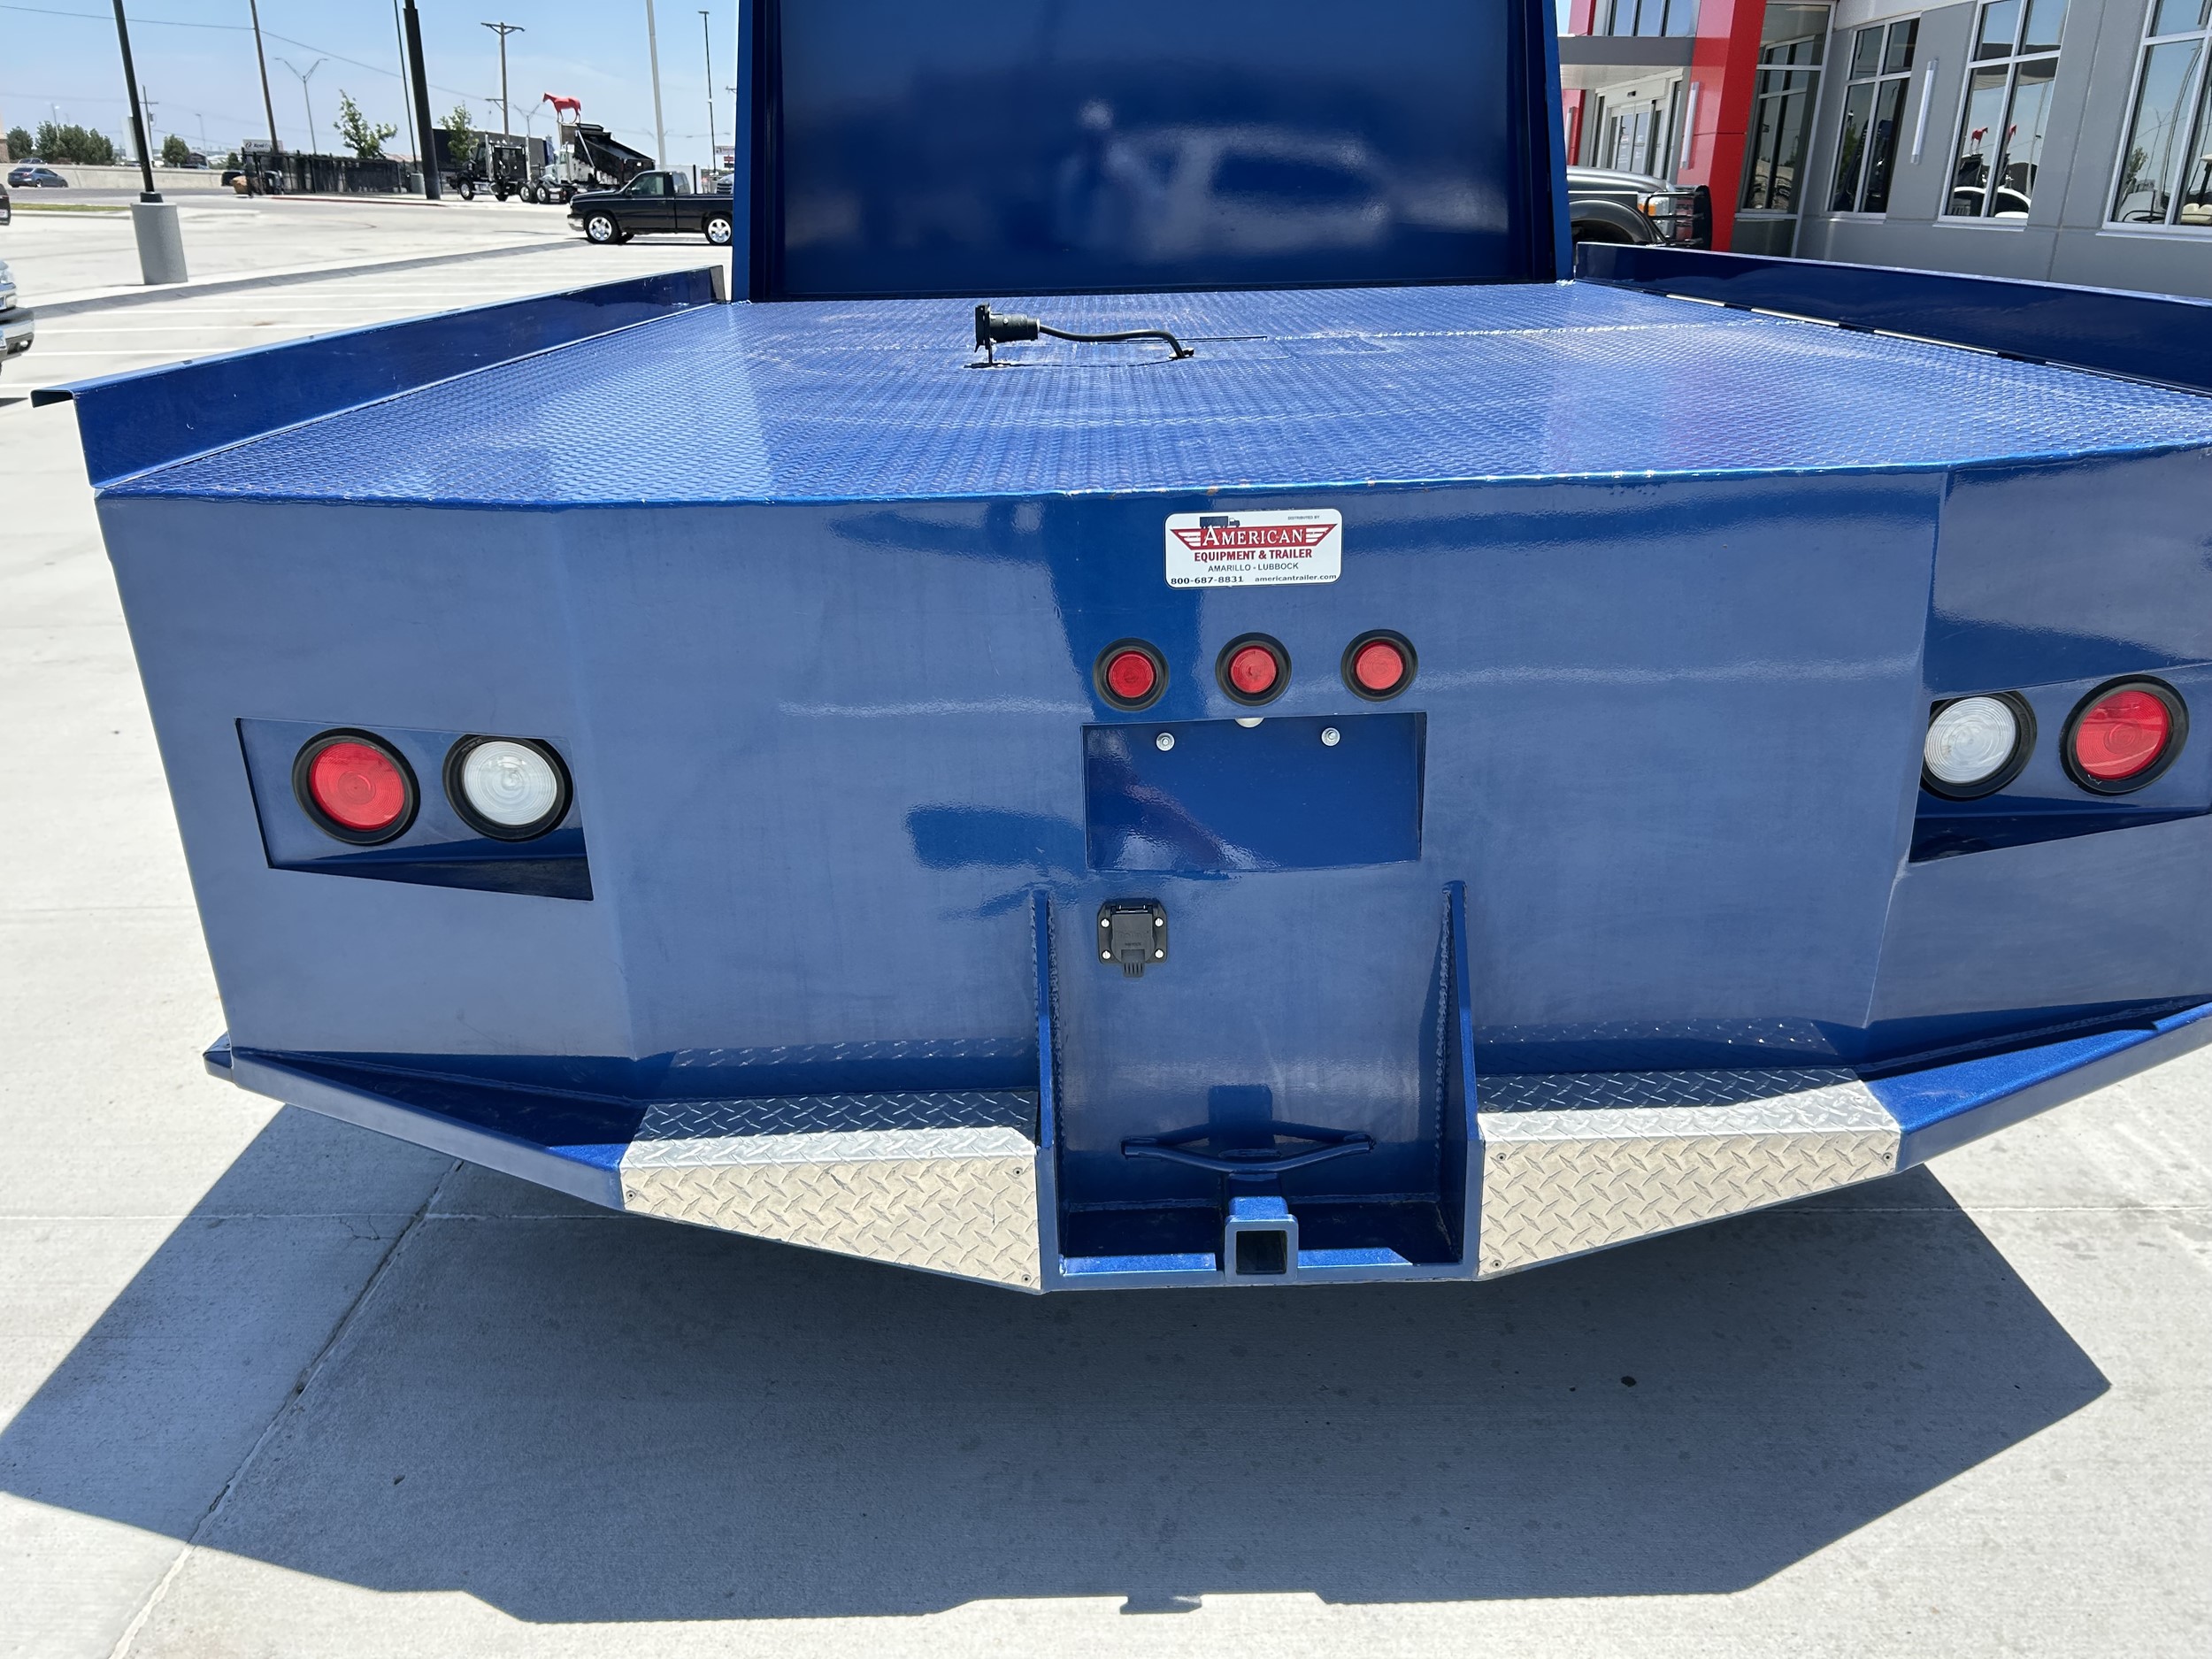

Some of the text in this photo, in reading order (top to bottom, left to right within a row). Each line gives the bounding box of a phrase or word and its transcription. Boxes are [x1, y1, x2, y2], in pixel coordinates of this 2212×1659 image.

[1202, 525, 1303, 546] AMERICAN
[1194, 549, 1312, 563] EQUIPMENT & TRAILER
[1208, 564, 1251, 572] AMARILLO
[1257, 562, 1299, 571] LUBBOCK
[1171, 576, 1244, 585] 800-687-8831
